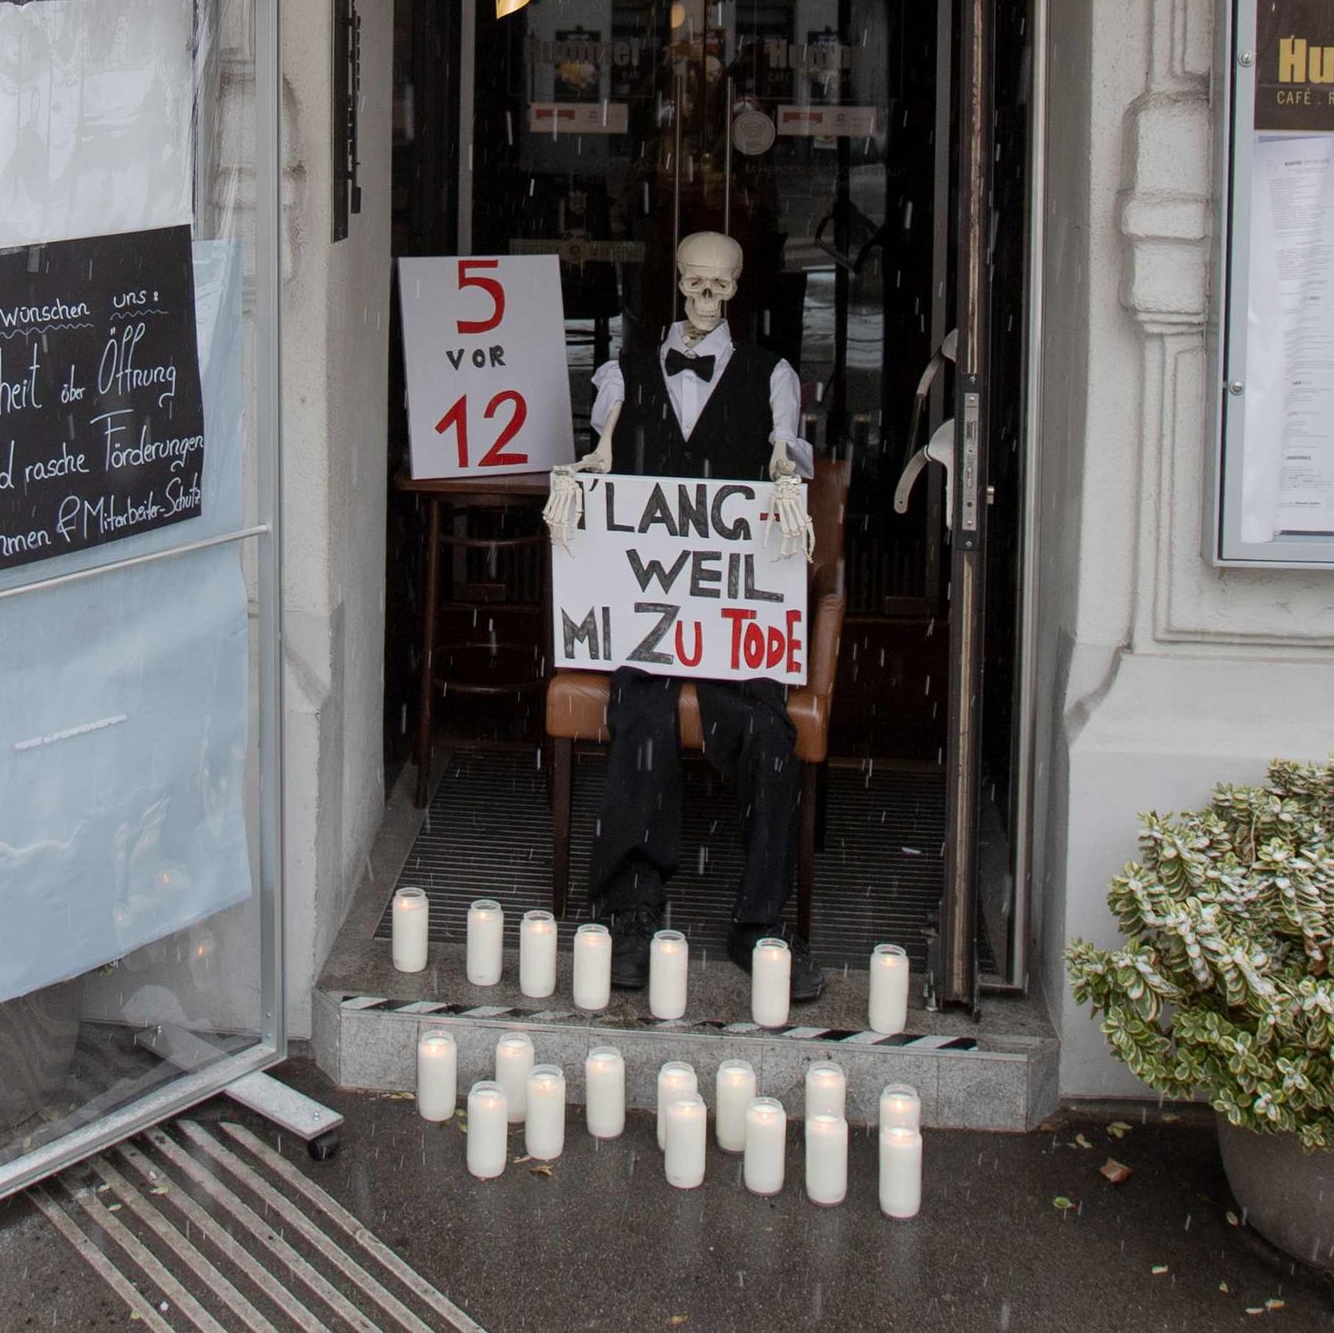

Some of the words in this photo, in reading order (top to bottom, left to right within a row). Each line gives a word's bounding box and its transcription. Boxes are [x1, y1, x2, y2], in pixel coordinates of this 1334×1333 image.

[1276, 87, 1313, 106] CAFÉ
[456, 259, 506, 335] 5
[446, 345, 506, 370] VOR
[24, 442, 91, 485] rasche
[89, 408, 205, 473] Förderungen
[434, 389, 529, 469] 12
[626, 549, 784, 602] WEIL
[561, 606, 612, 660] MI
[626, 602, 703, 667] ZU
[721, 609, 802, 673] TODE
